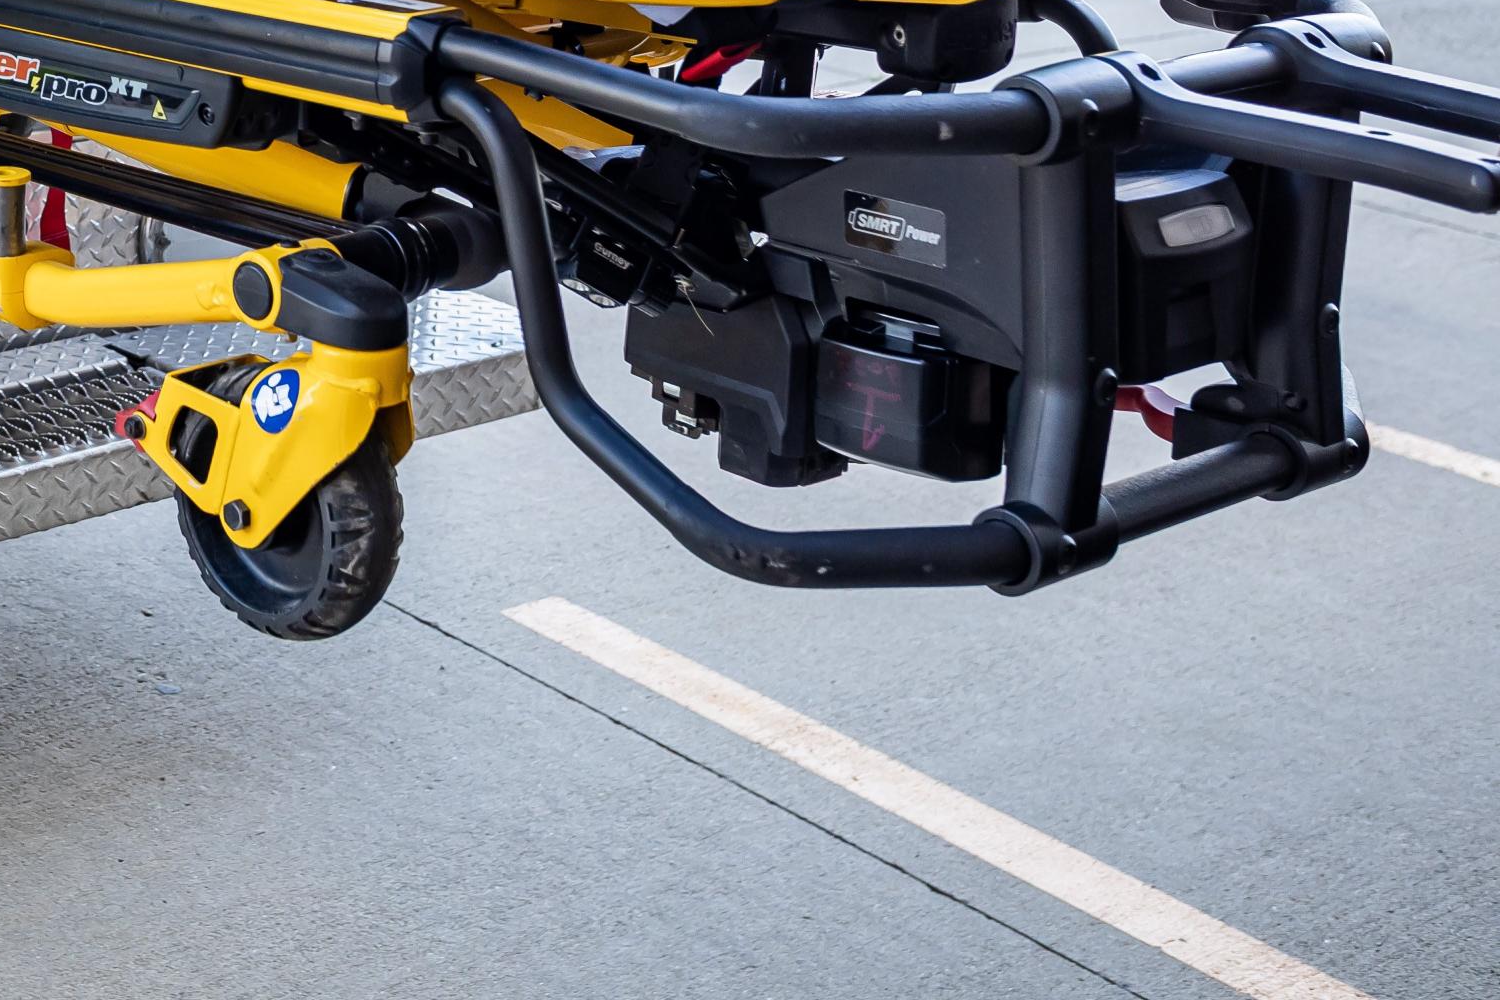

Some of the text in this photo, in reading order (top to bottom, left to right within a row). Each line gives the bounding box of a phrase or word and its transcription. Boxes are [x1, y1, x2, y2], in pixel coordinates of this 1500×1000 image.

[40, 73, 107, 105] pro
[108, 75, 148, 98] XT
[857, 213, 900, 235] SMRT
